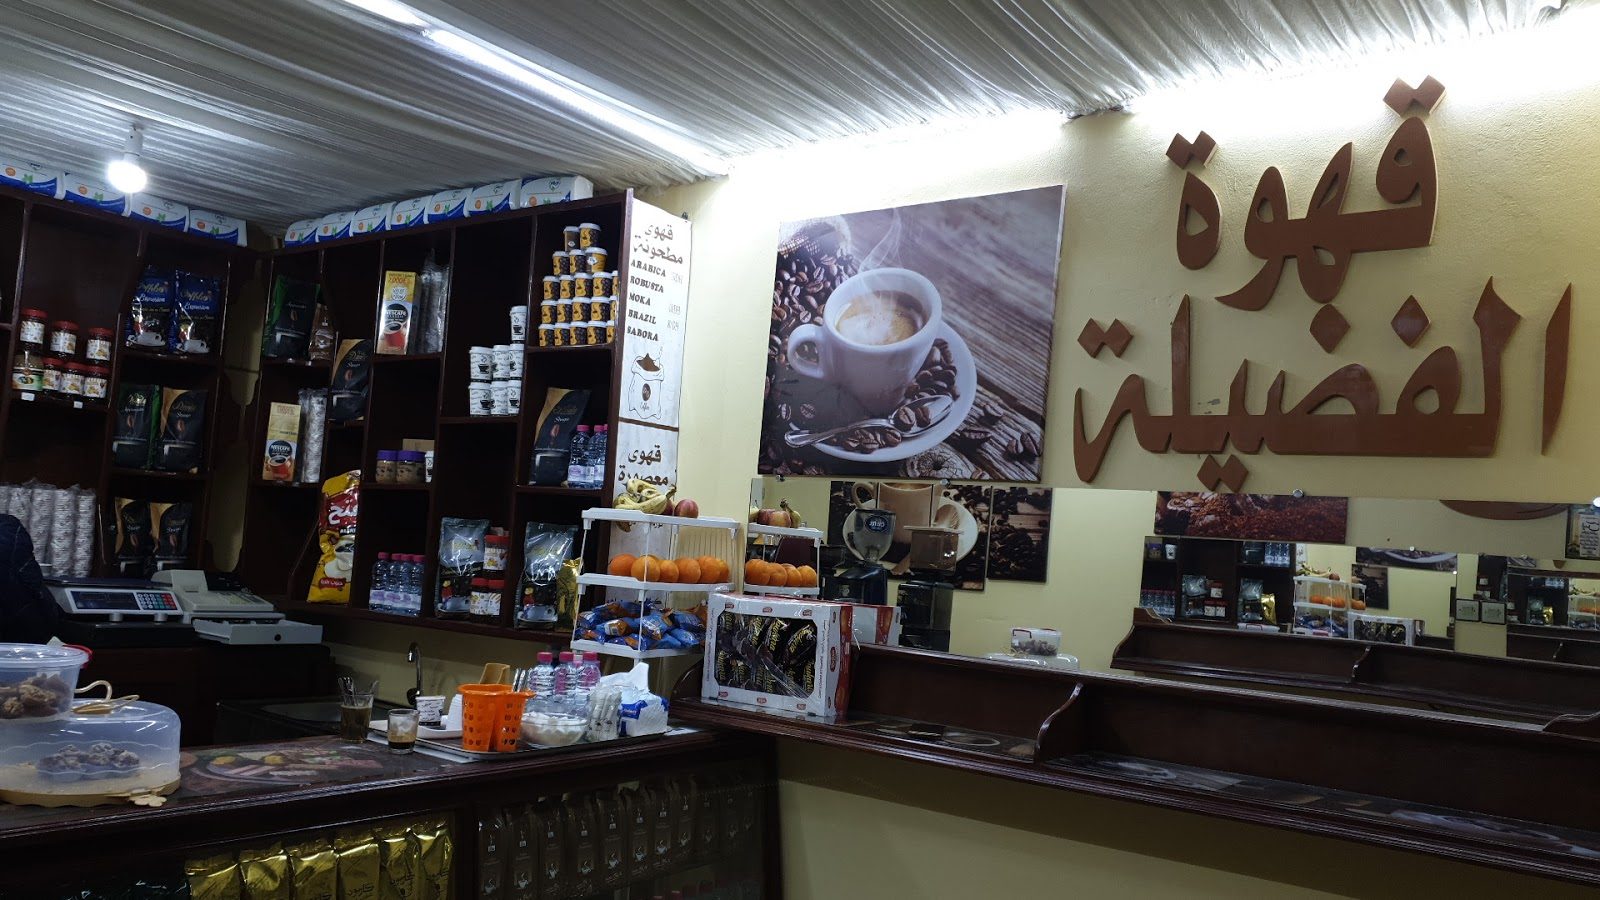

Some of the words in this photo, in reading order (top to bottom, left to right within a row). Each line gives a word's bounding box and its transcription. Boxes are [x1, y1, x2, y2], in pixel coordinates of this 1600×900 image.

[1166, 75, 1447, 312] قهوة
[633, 235, 683, 265] مطحونة
[630, 259, 667, 278] ARABICA
[629, 275, 665, 294] ROBUSTA
[628, 292, 652, 307] MOKA
[627, 309, 657, 326] BRAZIL
[626, 326, 659, 342] SABORA
[1073, 276, 1572, 493] الفضيلة
